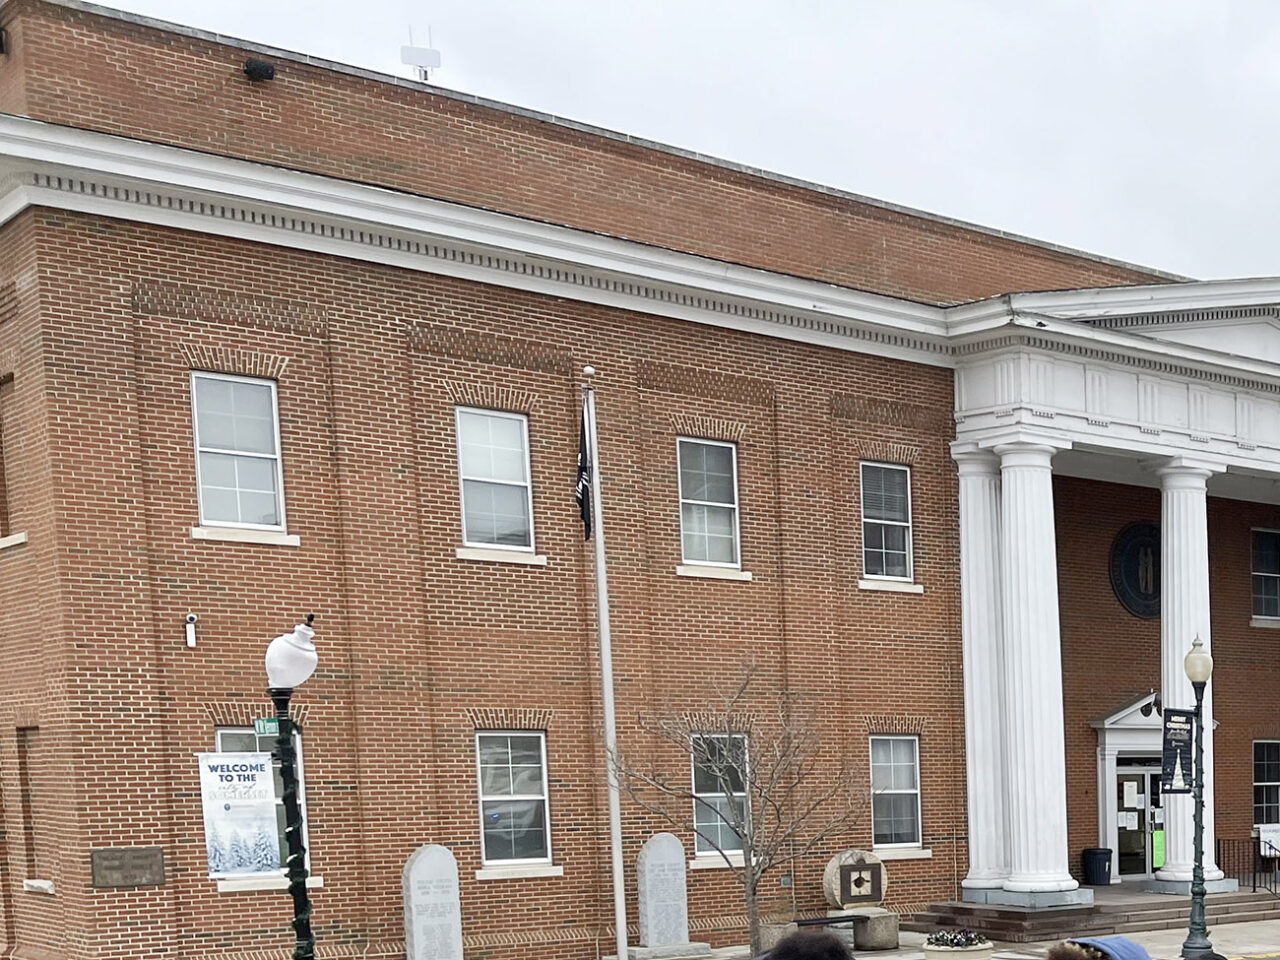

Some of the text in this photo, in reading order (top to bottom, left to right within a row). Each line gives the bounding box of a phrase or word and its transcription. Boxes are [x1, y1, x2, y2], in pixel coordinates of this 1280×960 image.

[208, 764, 266, 773] WELCOME
[218, 774, 257, 782] TO THE
